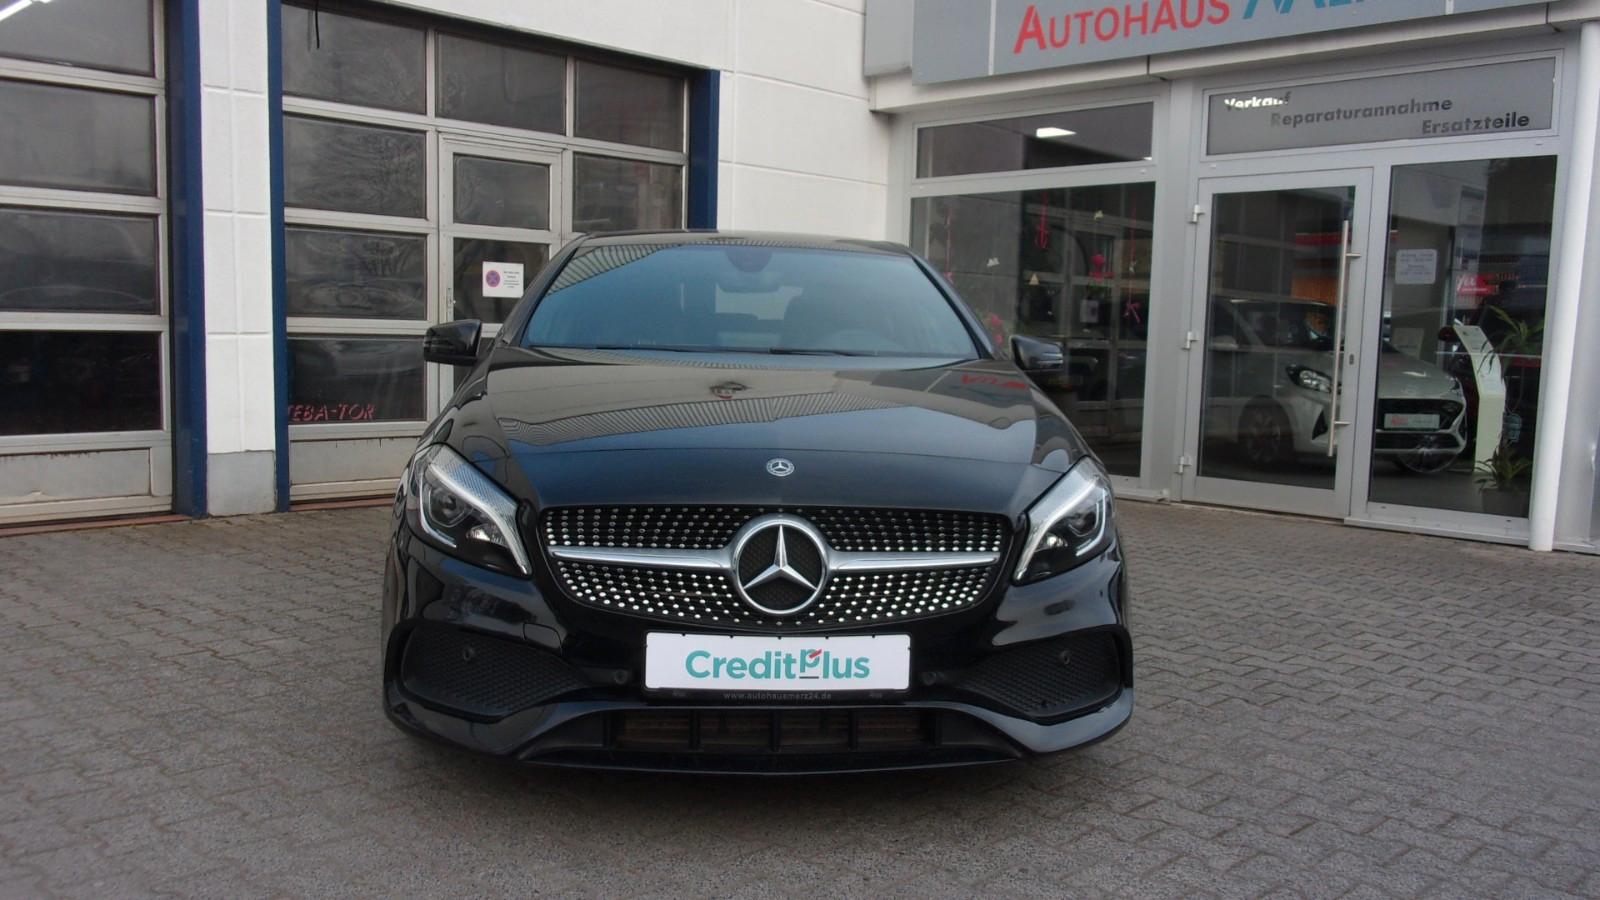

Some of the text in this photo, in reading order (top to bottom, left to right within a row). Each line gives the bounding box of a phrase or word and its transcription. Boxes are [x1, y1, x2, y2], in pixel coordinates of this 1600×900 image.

[1013, 0, 1229, 54] AUTOHAUS
[1224, 91, 1292, 111] Verkauf
[1270, 98, 1453, 128] Reparaturannahme
[1422, 112, 1530, 134] Ersatzteile
[685, 648, 871, 680] CreditPlus
[723, 691, 832, 700] www.autohausmerz24.de
